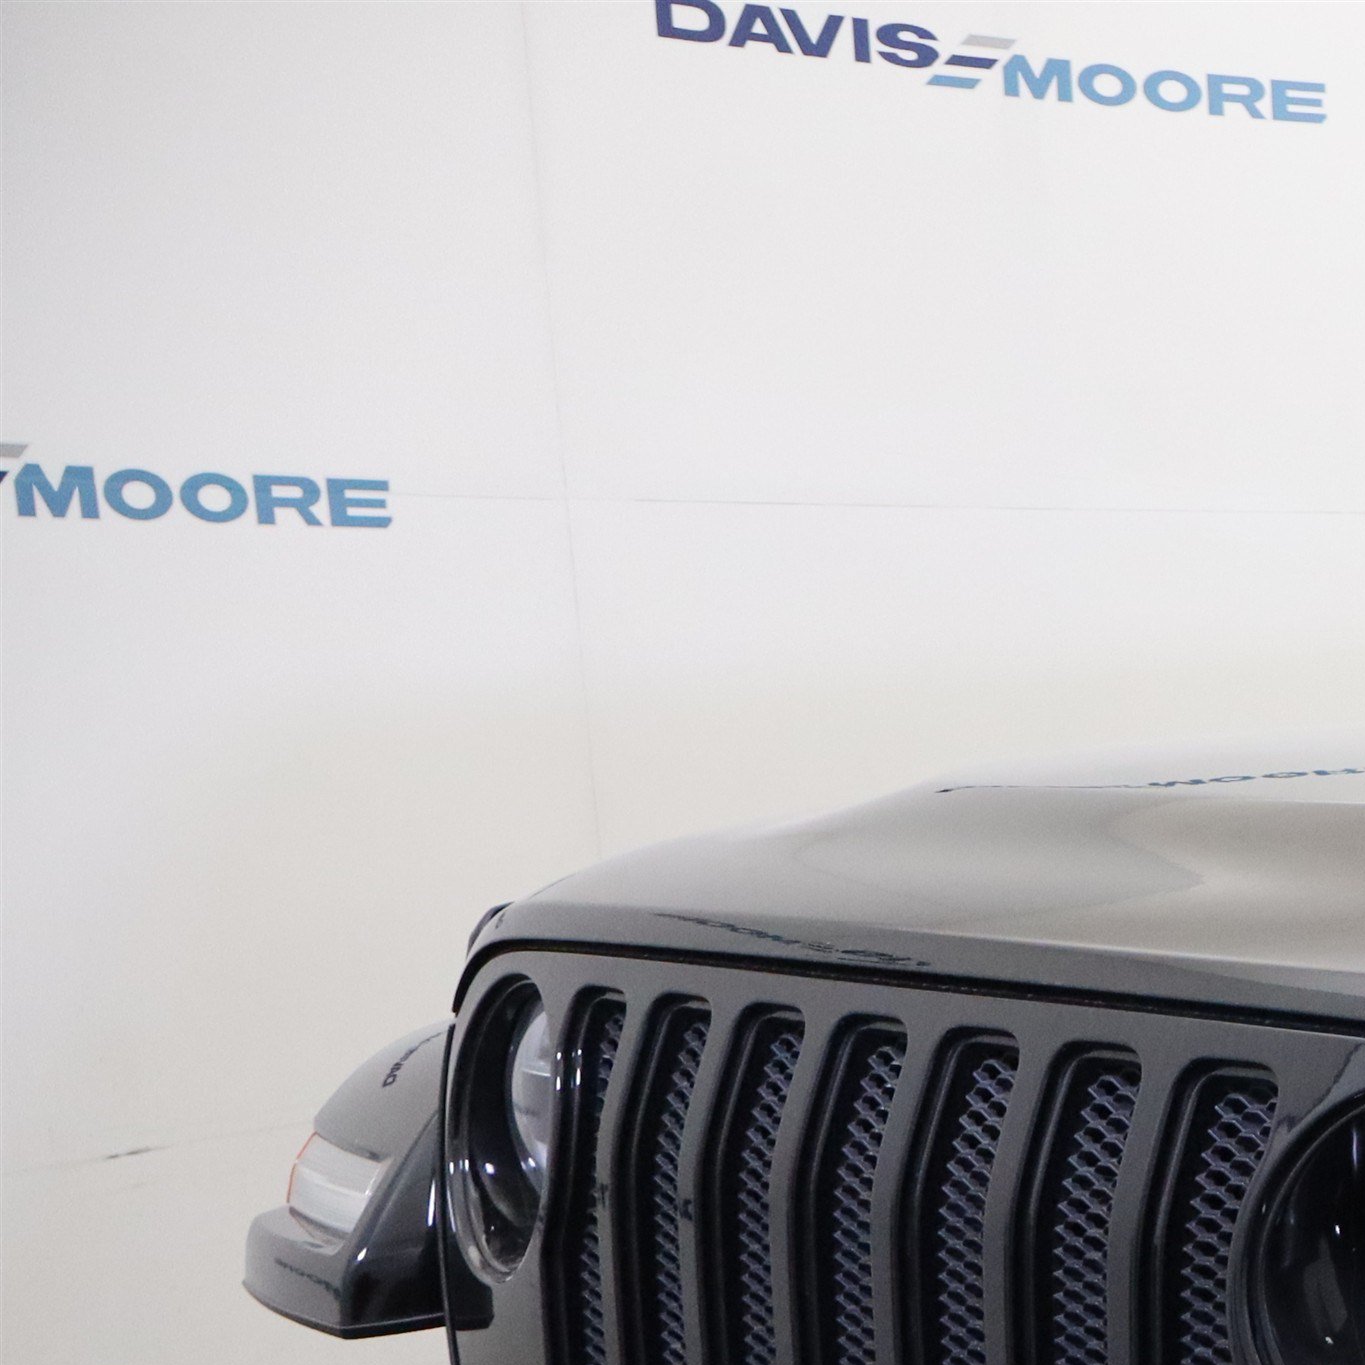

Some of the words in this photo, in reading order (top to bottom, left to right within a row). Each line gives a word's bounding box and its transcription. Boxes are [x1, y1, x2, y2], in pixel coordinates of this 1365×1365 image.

[655, 0, 940, 69] DAVIS
[1003, 54, 1328, 124] MOORE
[14, 463, 392, 528] MOORE
